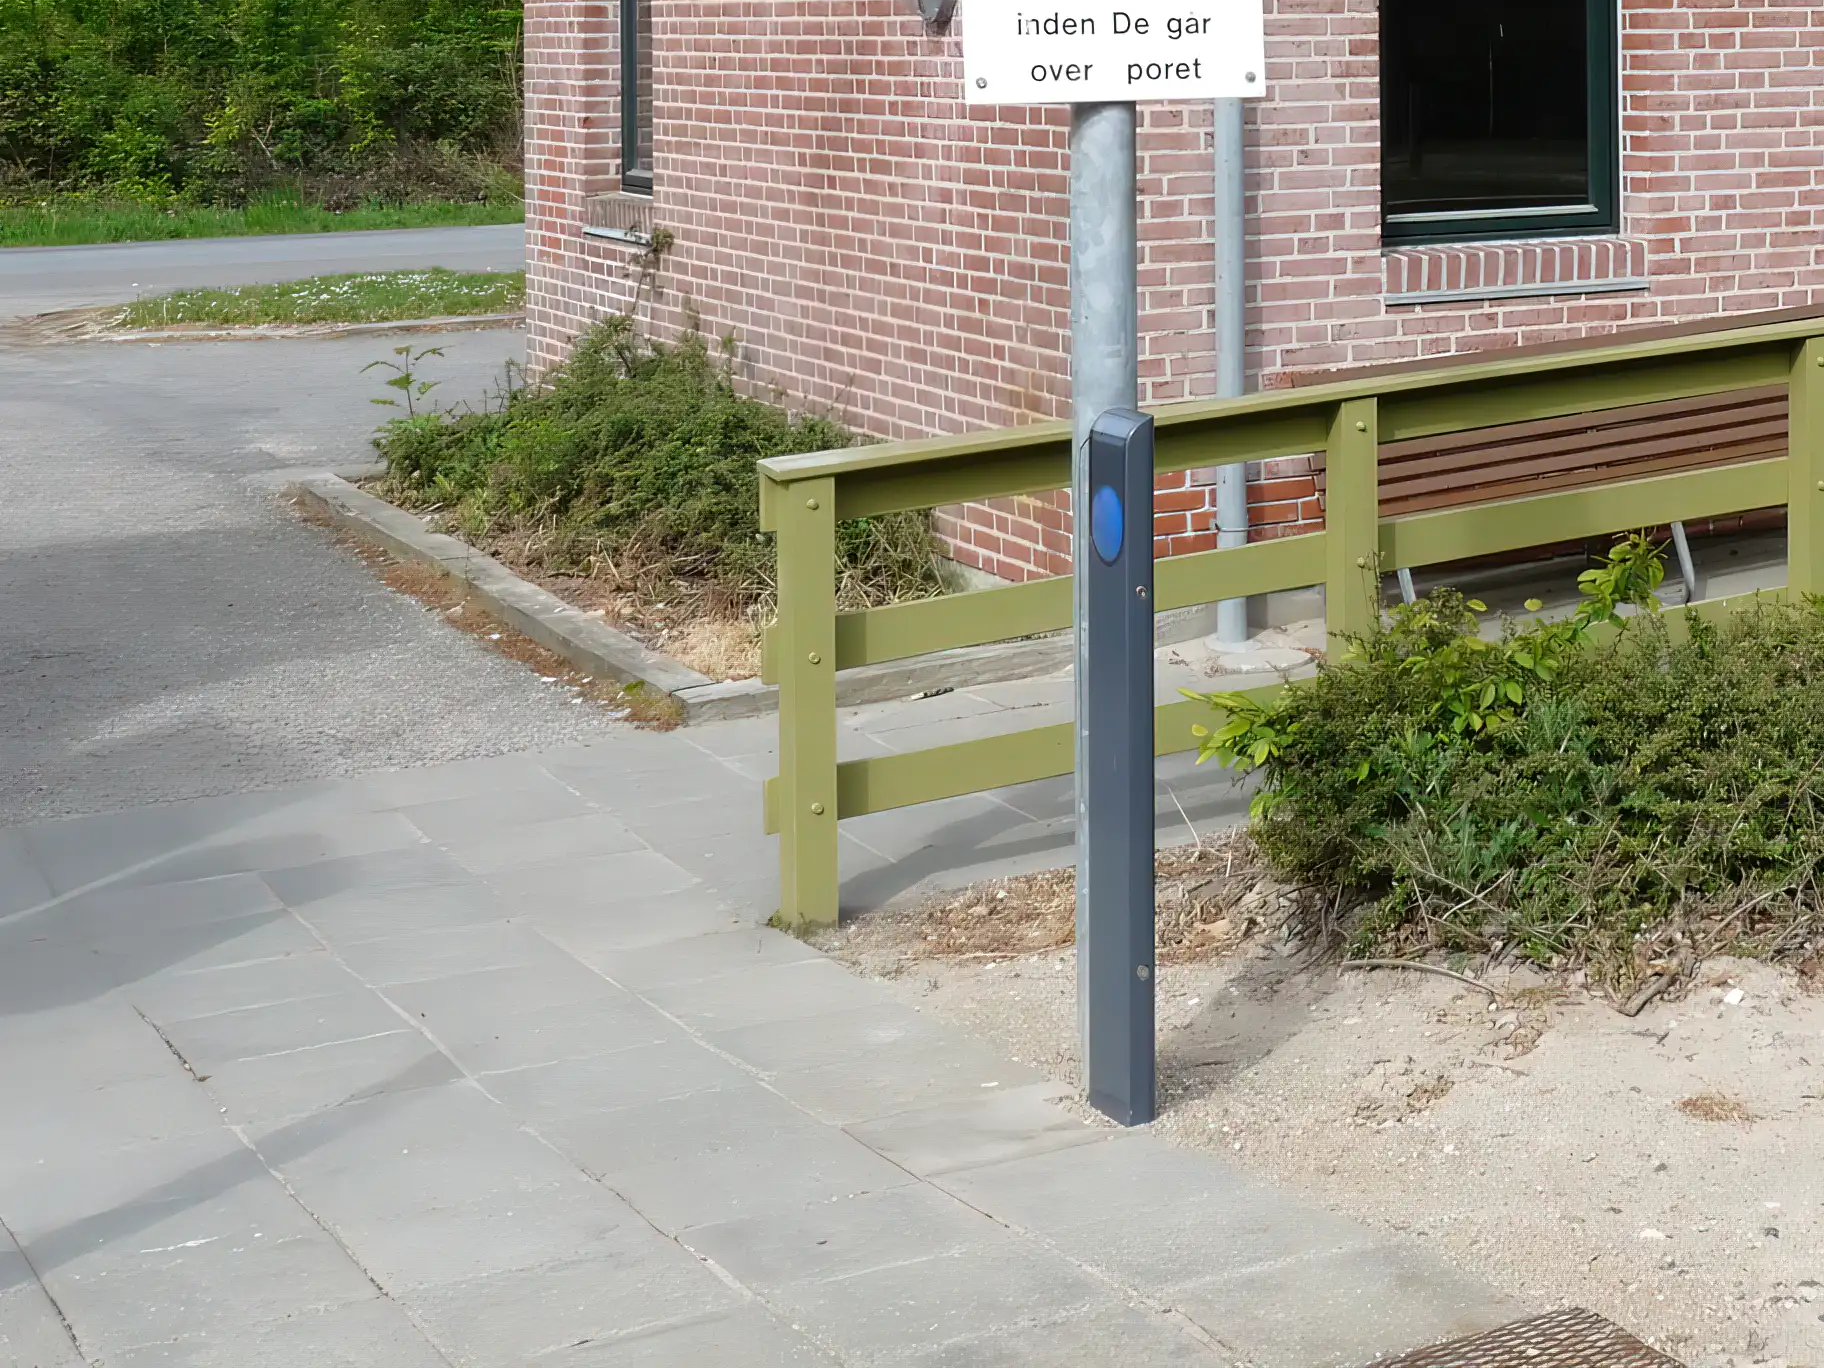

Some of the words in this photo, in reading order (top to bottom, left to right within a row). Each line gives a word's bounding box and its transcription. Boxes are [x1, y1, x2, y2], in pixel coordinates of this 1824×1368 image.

[1017, 12, 1095, 36] inden
[1113, 11, 1150, 35] De
[1030, 62, 1093, 82] over
[1127, 58, 1202, 84] poret
